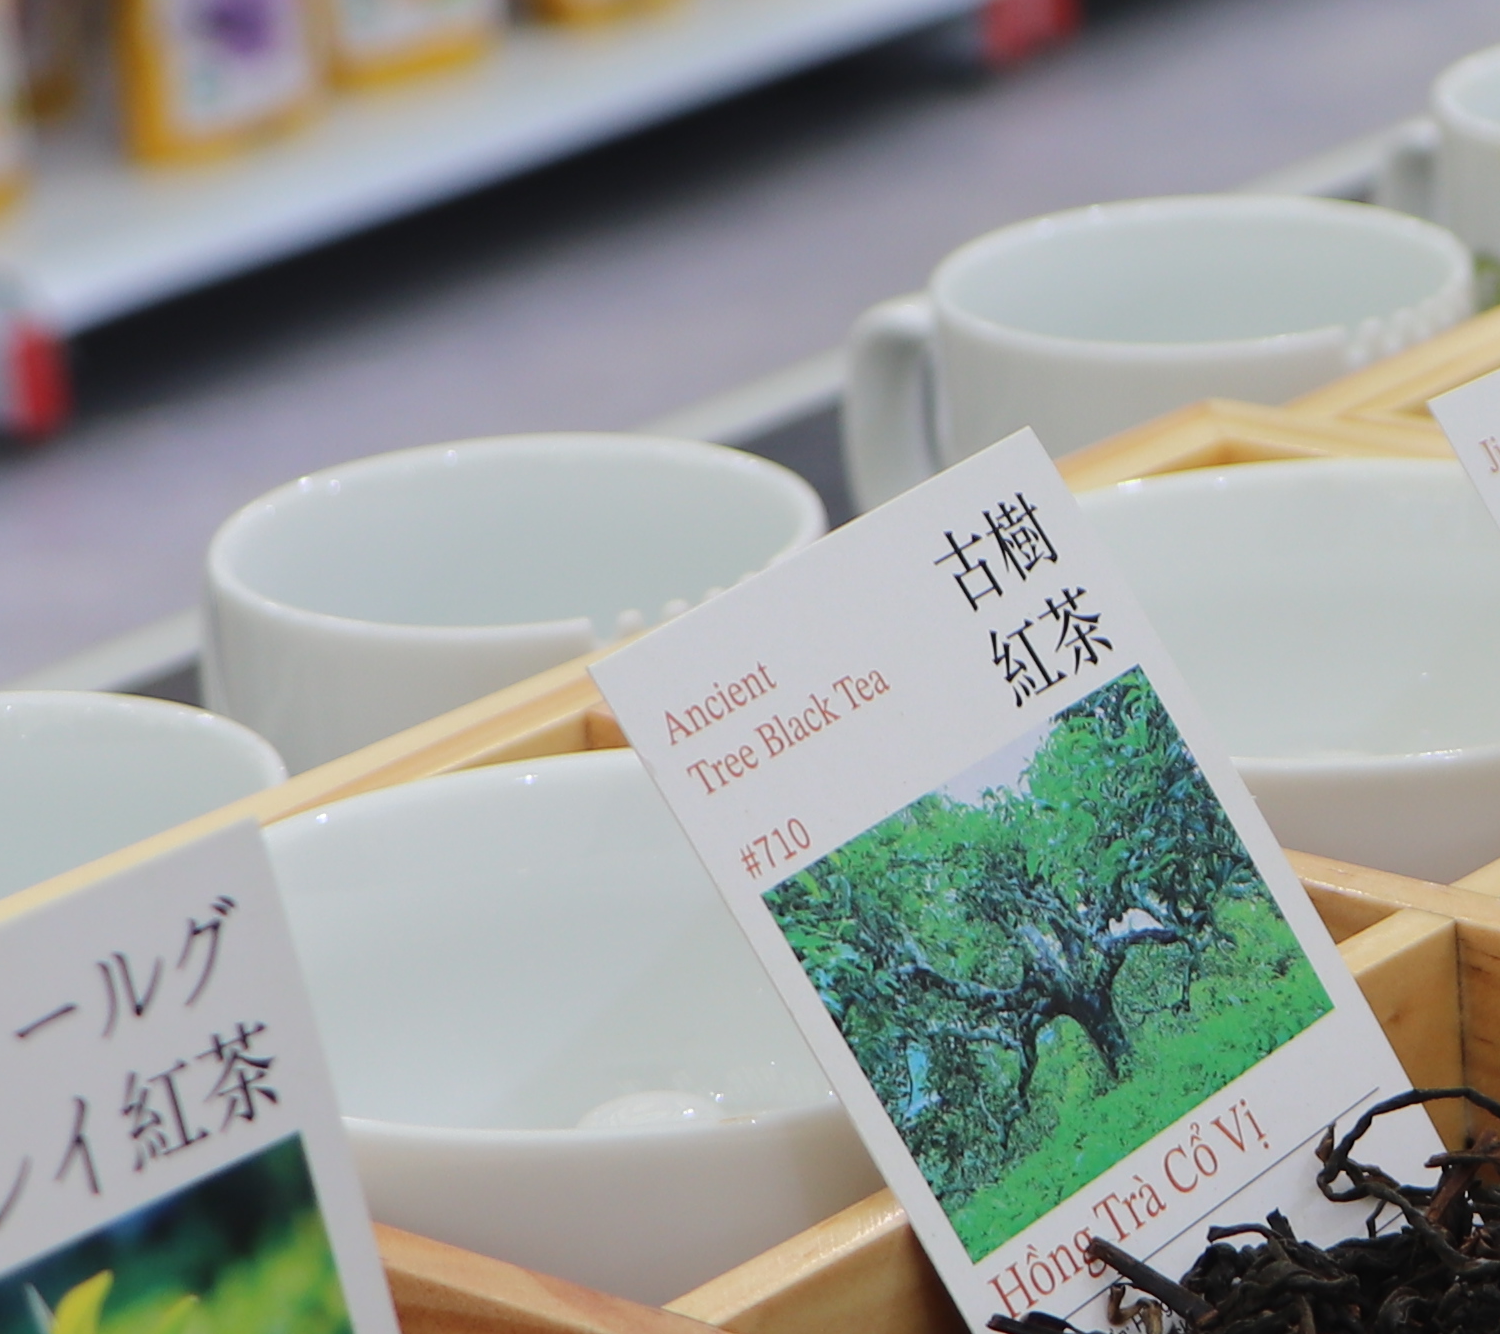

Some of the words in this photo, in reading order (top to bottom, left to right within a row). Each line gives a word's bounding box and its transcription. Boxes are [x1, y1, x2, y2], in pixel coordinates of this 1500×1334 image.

[933, 492, 1058, 612] 古樹
[664, 660, 778, 746] Ancient
[989, 586, 1114, 708] 紅茶
[686, 743, 760, 795] Tree
[753, 693, 842, 759] Black
[832, 668, 891, 711] Tea
[739, 817, 812, 880] #710
[987, 1227, 1108, 1319] Hồng
[1092, 1174, 1168, 1243] Trà
[1163, 1121, 1219, 1194] Cổ
[1211, 1098, 1270, 1153] Vị
